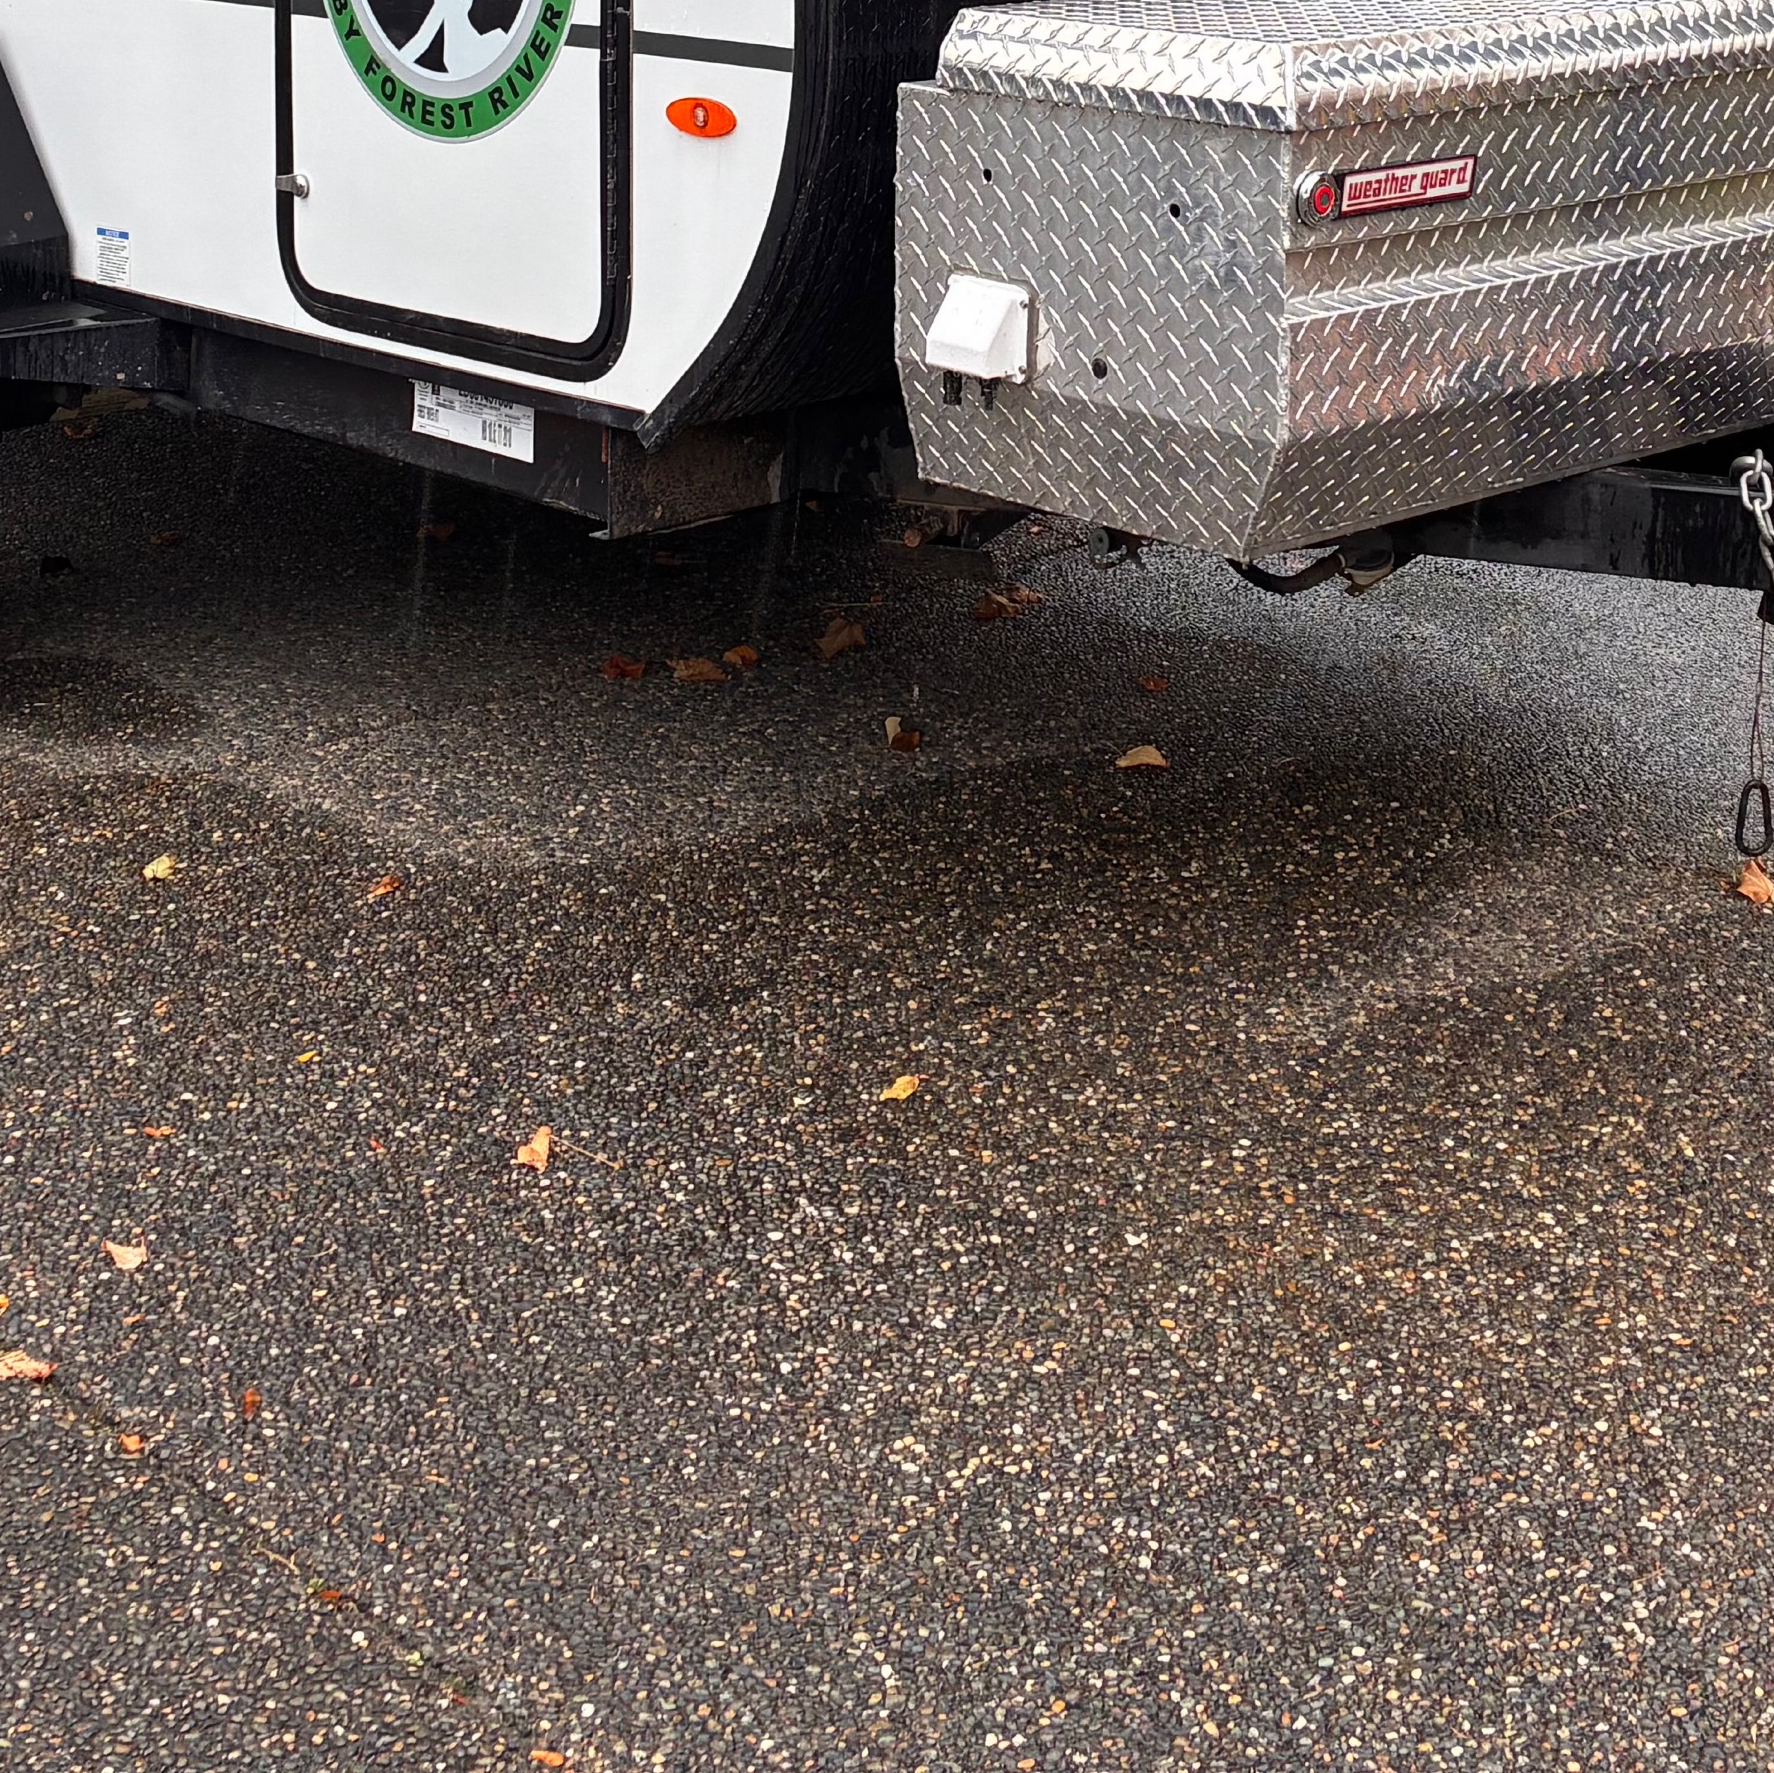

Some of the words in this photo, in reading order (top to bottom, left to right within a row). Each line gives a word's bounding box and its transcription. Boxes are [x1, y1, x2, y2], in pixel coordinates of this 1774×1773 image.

[364, 59, 475, 130] FOREST
[491, 1, 564, 117] RIVER
[1347, 172, 1417, 200] weather
[1420, 162, 1468, 194] guard
